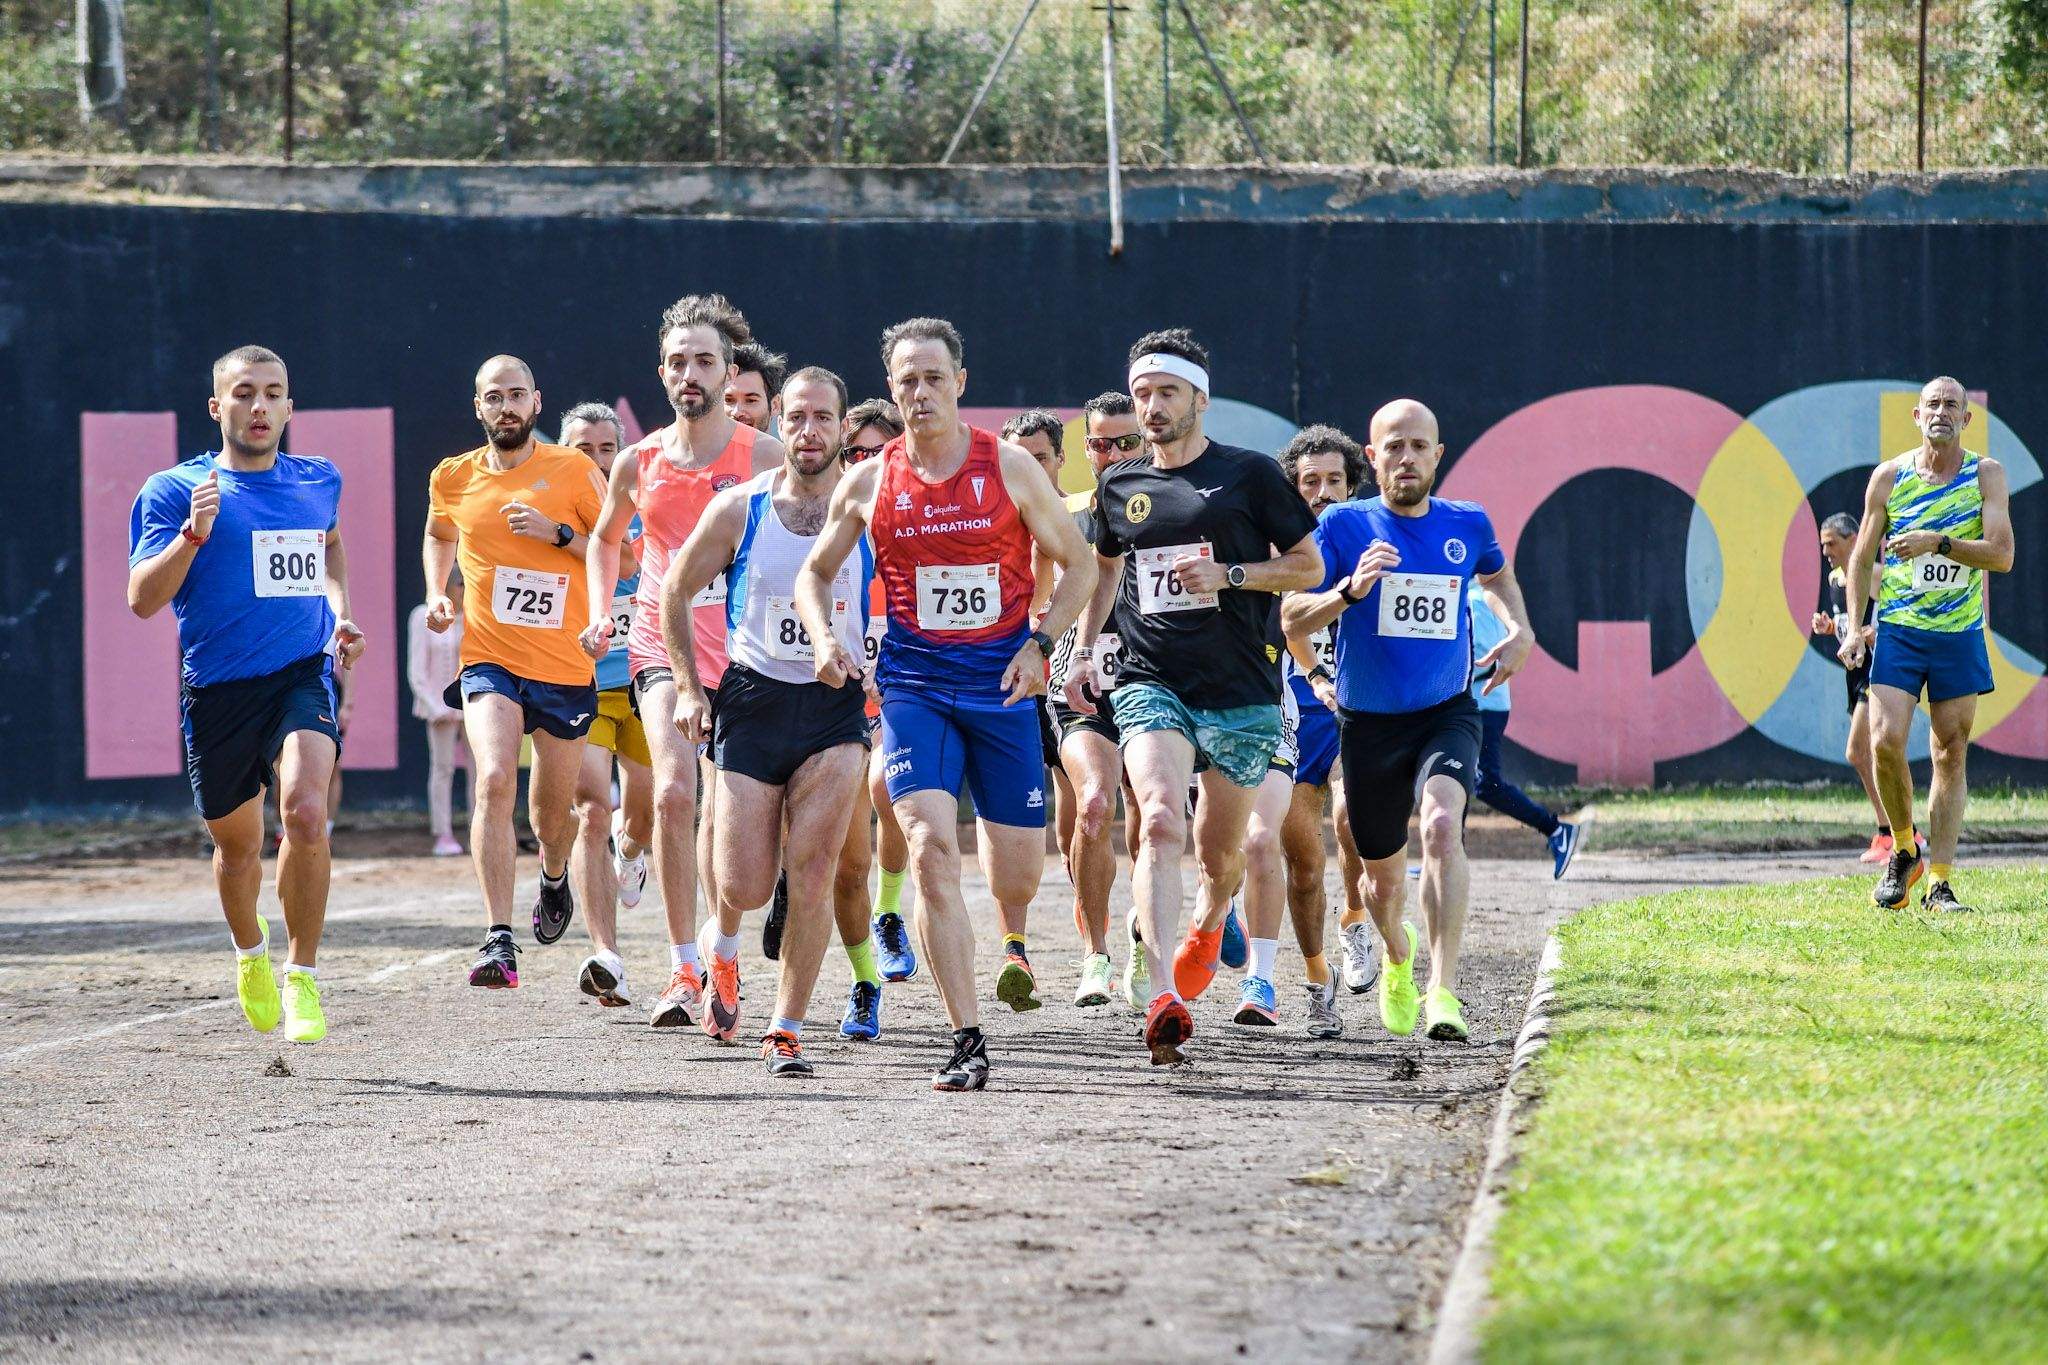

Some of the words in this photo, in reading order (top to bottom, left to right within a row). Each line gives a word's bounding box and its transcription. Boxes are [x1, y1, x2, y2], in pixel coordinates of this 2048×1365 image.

[895, 527, 918, 539] A.D.
[920, 518, 992, 535] MARATHON
[269, 552, 316, 581] 806
[1923, 564, 1961, 583] 807
[1150, 569, 1194, 598] 76
[506, 586, 554, 616] 725
[932, 587, 987, 615] 736
[1198, 596, 1215, 605] 2023
[1394, 594, 1446, 624] 868
[982, 615, 997, 624] 2023
